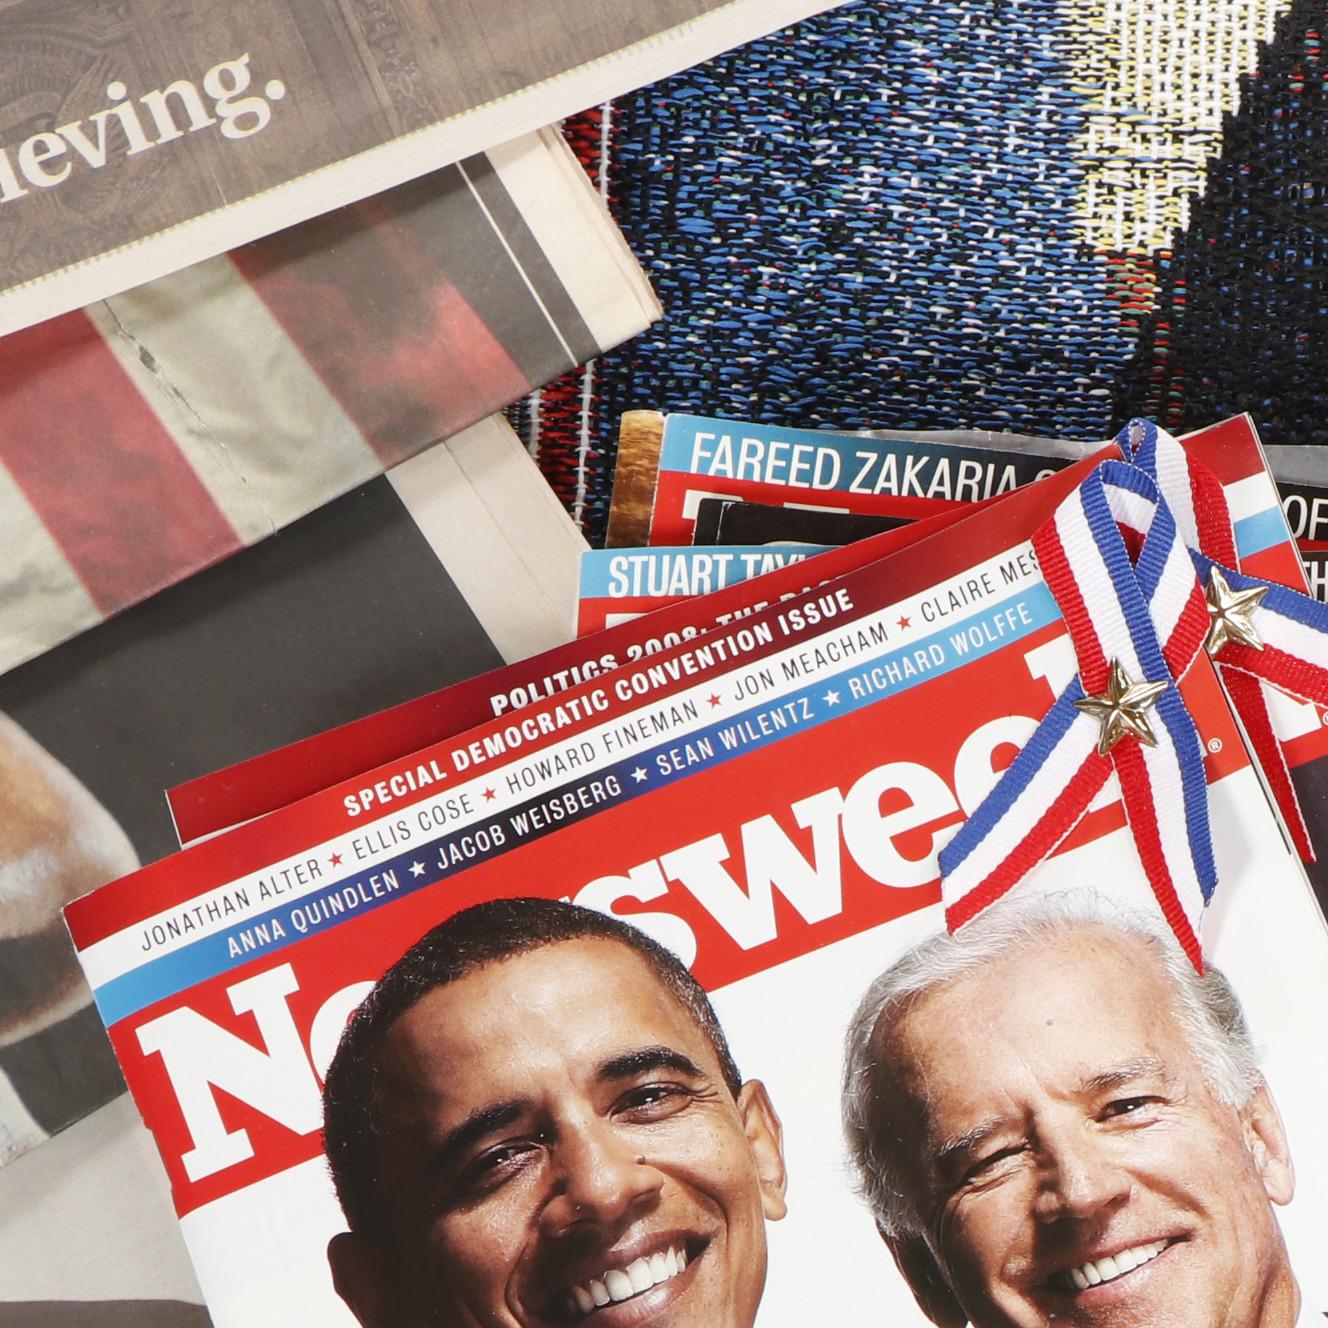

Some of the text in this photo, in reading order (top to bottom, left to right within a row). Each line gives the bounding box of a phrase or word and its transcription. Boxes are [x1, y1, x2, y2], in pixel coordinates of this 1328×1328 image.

[689, 433, 1018, 502] FAREED ZAKARIA
[608, 553, 733, 597] STUART
[343, 760, 447, 818] SPECIAL
[451, 688, 610, 774] DEMOCRATIC
[614, 620, 774, 703] CONVENTION
[779, 587, 855, 638] ISSUE
[490, 654, 619, 717] POLITICS
[140, 573, 996, 952] JONATHAN ALTER ELLIS COSE HOWARD FINEMAN JON MEACHAM CLAIRE
[226, 601, 1034, 960] ANNA QUINDLEN JACOB WEISBERG SEAN WILENTZ RICHARD WOLFFE
